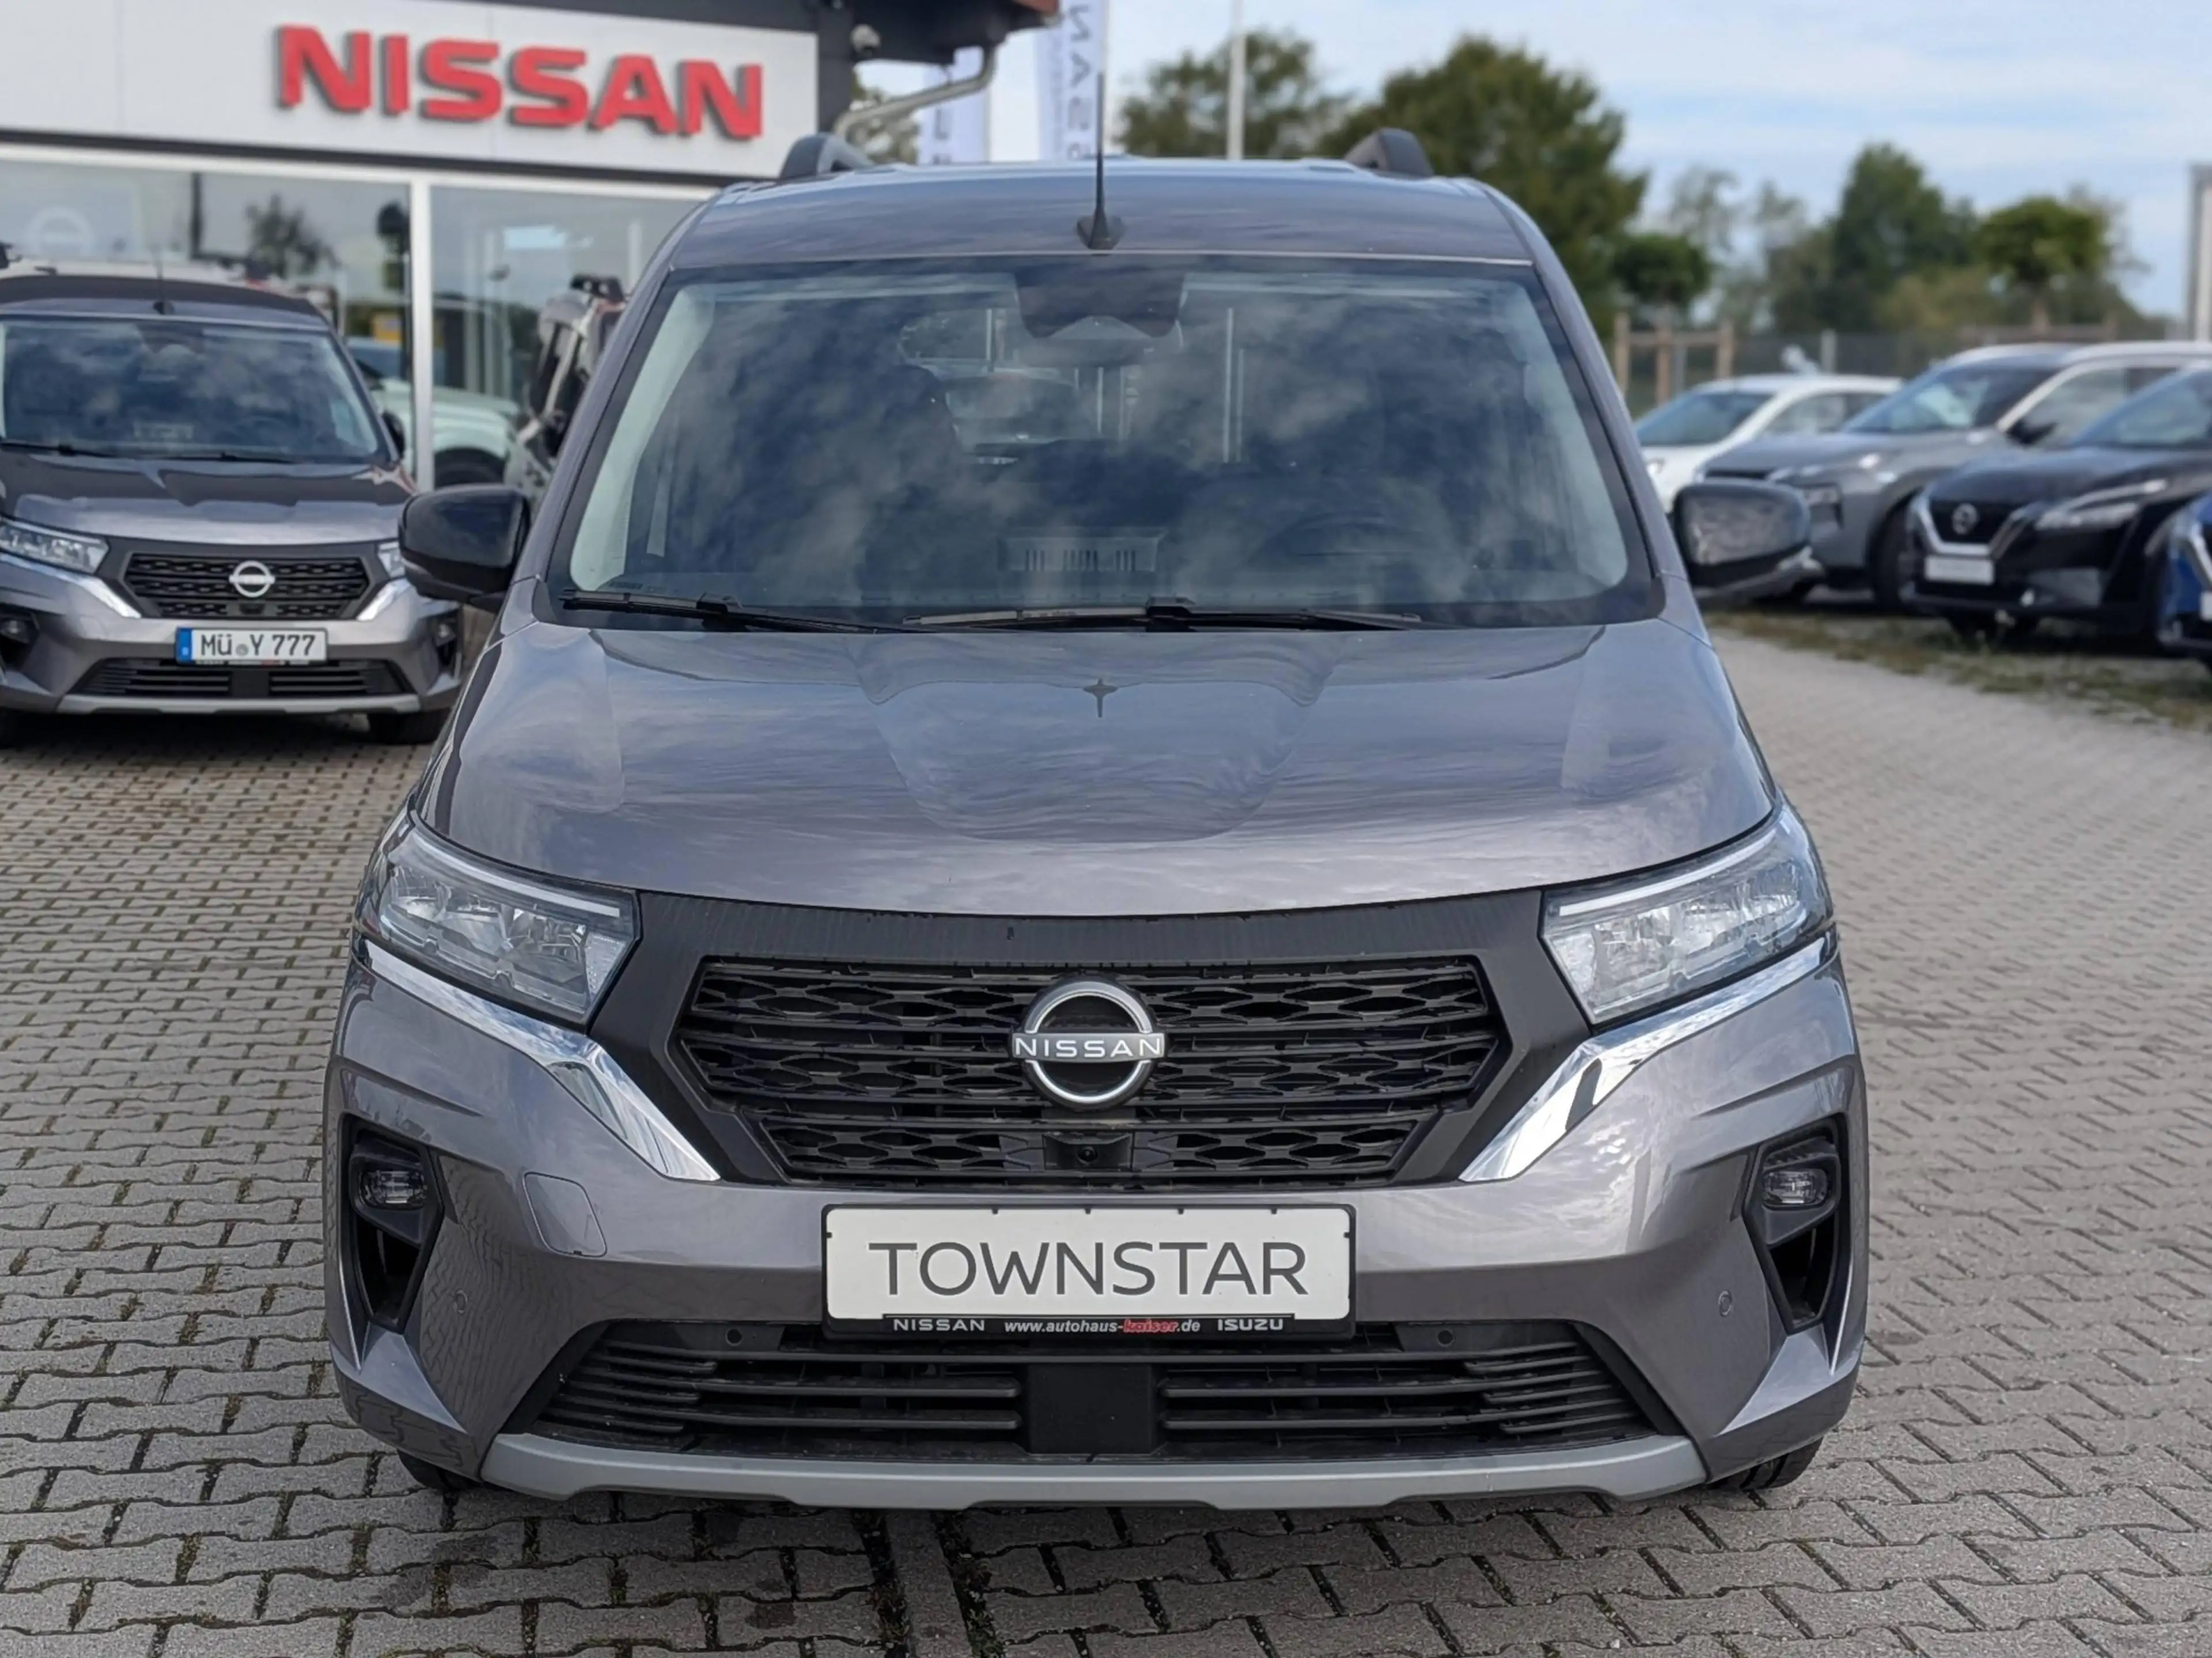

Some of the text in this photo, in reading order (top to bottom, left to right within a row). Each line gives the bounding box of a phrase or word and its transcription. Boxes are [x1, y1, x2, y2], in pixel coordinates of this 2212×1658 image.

[278, 24, 763, 139] NISSAN
[249, 635, 264, 655] Y
[272, 635, 316, 655] 777
[1015, 1037, 1161, 1058] NISSAN
[868, 1241, 1308, 1296] TOWNSTAR
[893, 1318, 1284, 1334] NISSAN www.autohaus-kaiser.de ISUZU
